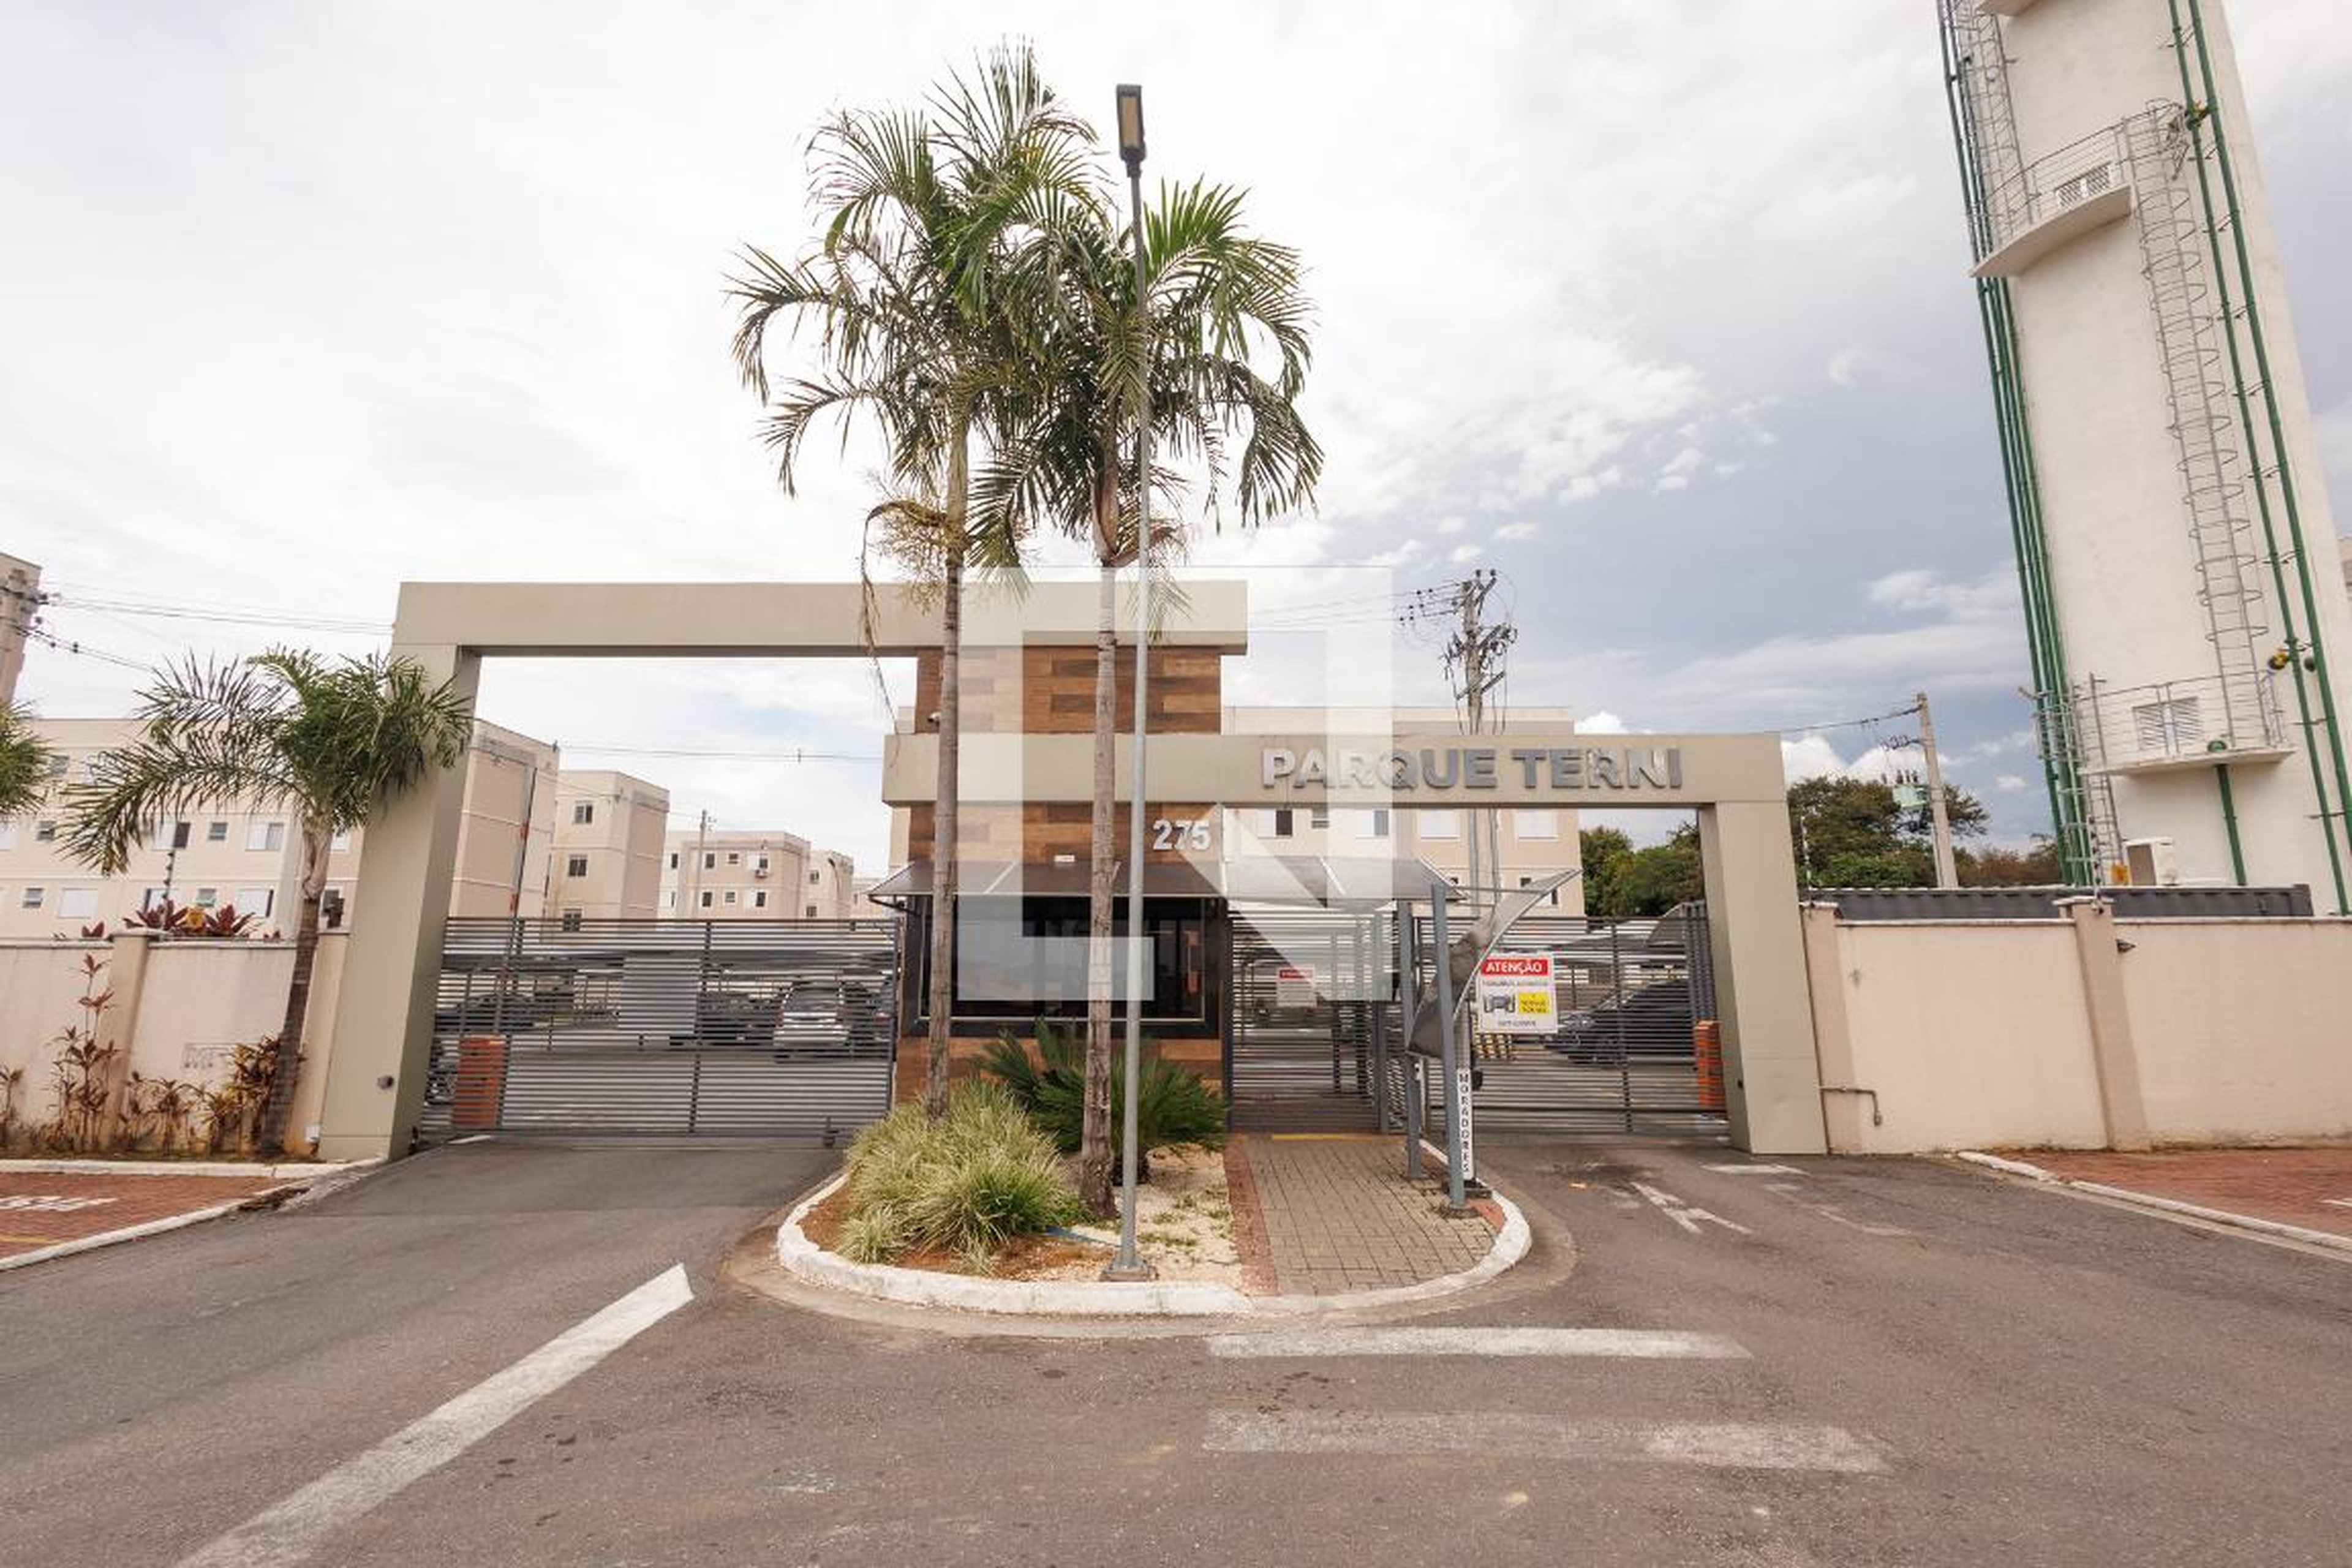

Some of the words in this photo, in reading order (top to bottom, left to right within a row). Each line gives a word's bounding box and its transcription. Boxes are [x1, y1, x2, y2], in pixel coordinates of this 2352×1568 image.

[1261, 748, 1497, 788] PARQUE
[1513, 748, 1683, 788] TERNI
[1152, 820, 1211, 851] 275
[1485, 959, 1542, 974] ATENÇÃO
[1459, 1073, 1470, 1172] MORADORES
